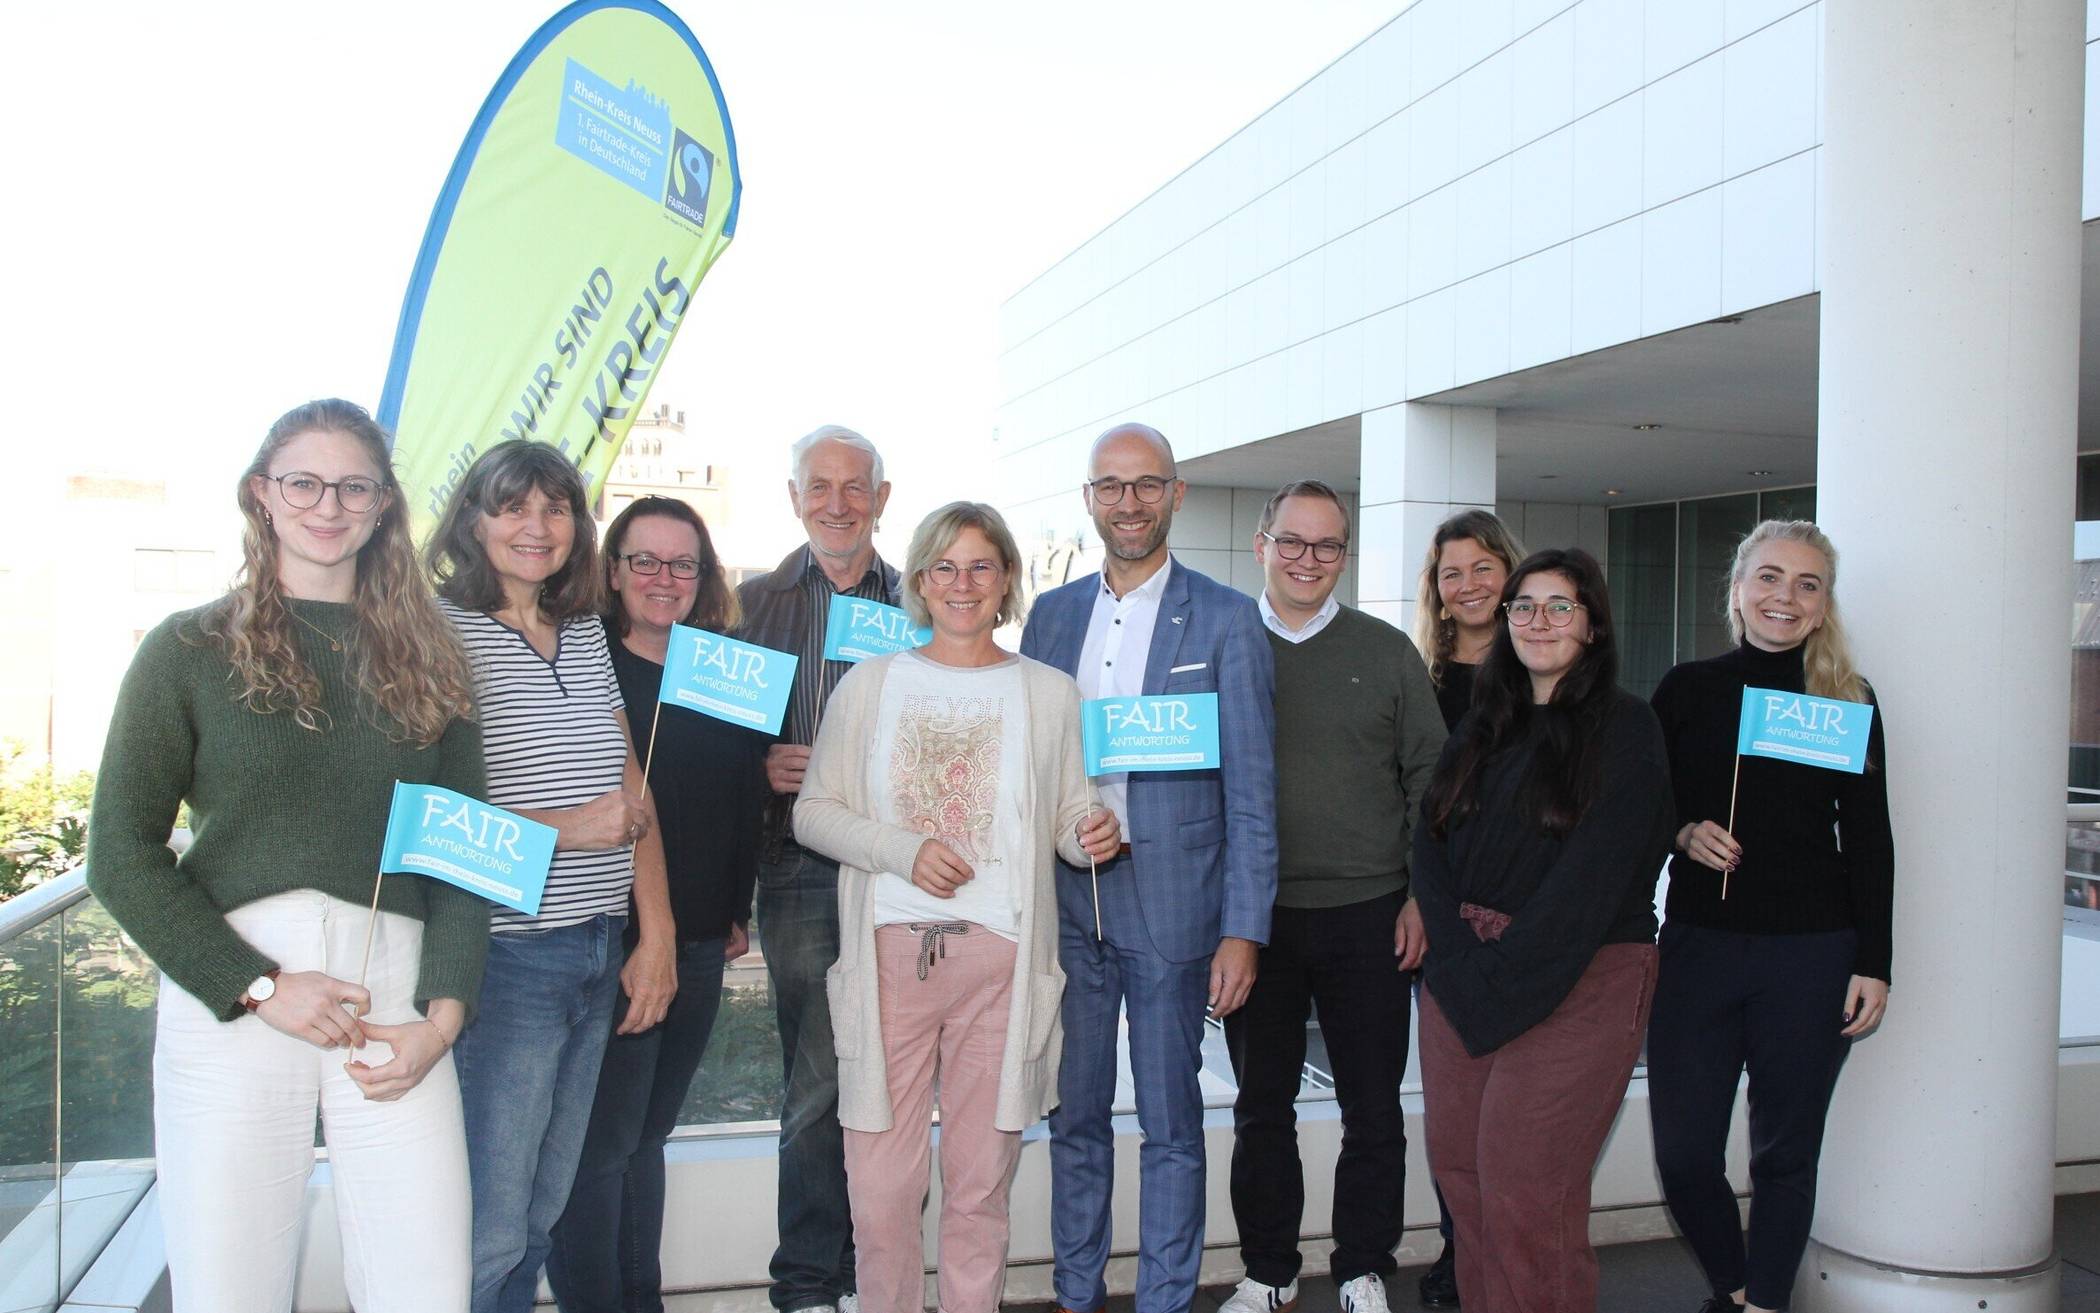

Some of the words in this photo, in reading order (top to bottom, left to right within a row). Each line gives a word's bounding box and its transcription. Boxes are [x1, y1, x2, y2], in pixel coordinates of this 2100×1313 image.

[574, 80, 632, 126] Rhein-Kreis
[633, 116, 663, 145] Neuss
[577, 113, 585, 128] 1.
[586, 118, 652, 167] Fairtrade-Kreis
[578, 132, 588, 147] in
[589, 138, 648, 182] Deutschland
[667, 195, 704, 224] FAIRTRADE
[500, 362, 563, 442] WIR
[555, 266, 613, 370] SIND
[428, 442, 477, 521] rhein
[692, 637, 769, 689] FAIR
[691, 672, 758, 701] ANTWORTUNG
[945, 696, 1004, 725] YOU
[1103, 700, 1197, 733] FAIR
[1764, 695, 1849, 735] FAIR
[1109, 734, 1191, 748] ANTWORTUNG
[1765, 725, 1840, 746] ANTWORTUNG
[422, 793, 525, 862] FAIR
[421, 833, 513, 875] ANTWORTUNG
